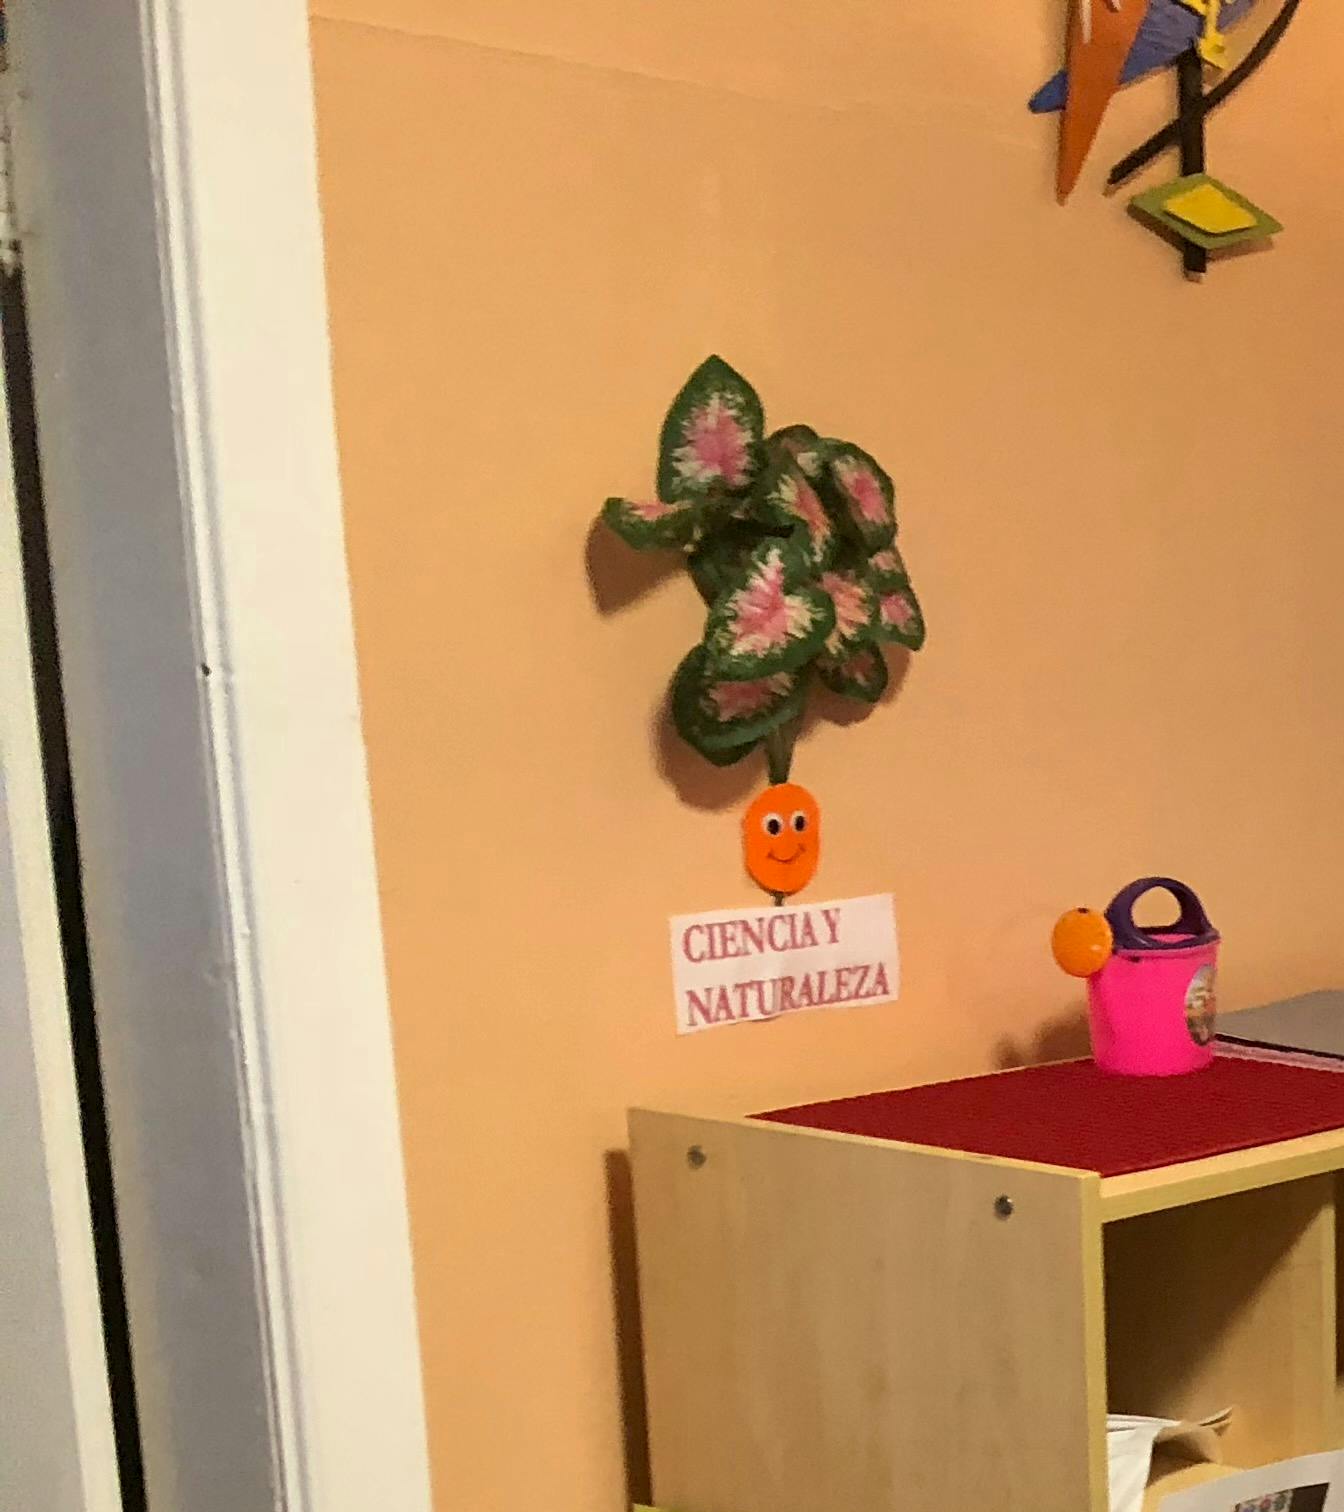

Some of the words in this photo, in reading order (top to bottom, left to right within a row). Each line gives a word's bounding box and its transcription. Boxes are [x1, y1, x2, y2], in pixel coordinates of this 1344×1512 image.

[683, 911, 819, 963] CIENCIA
[821, 907, 841, 944] Y
[686, 961, 889, 1027] NATURALEZA
